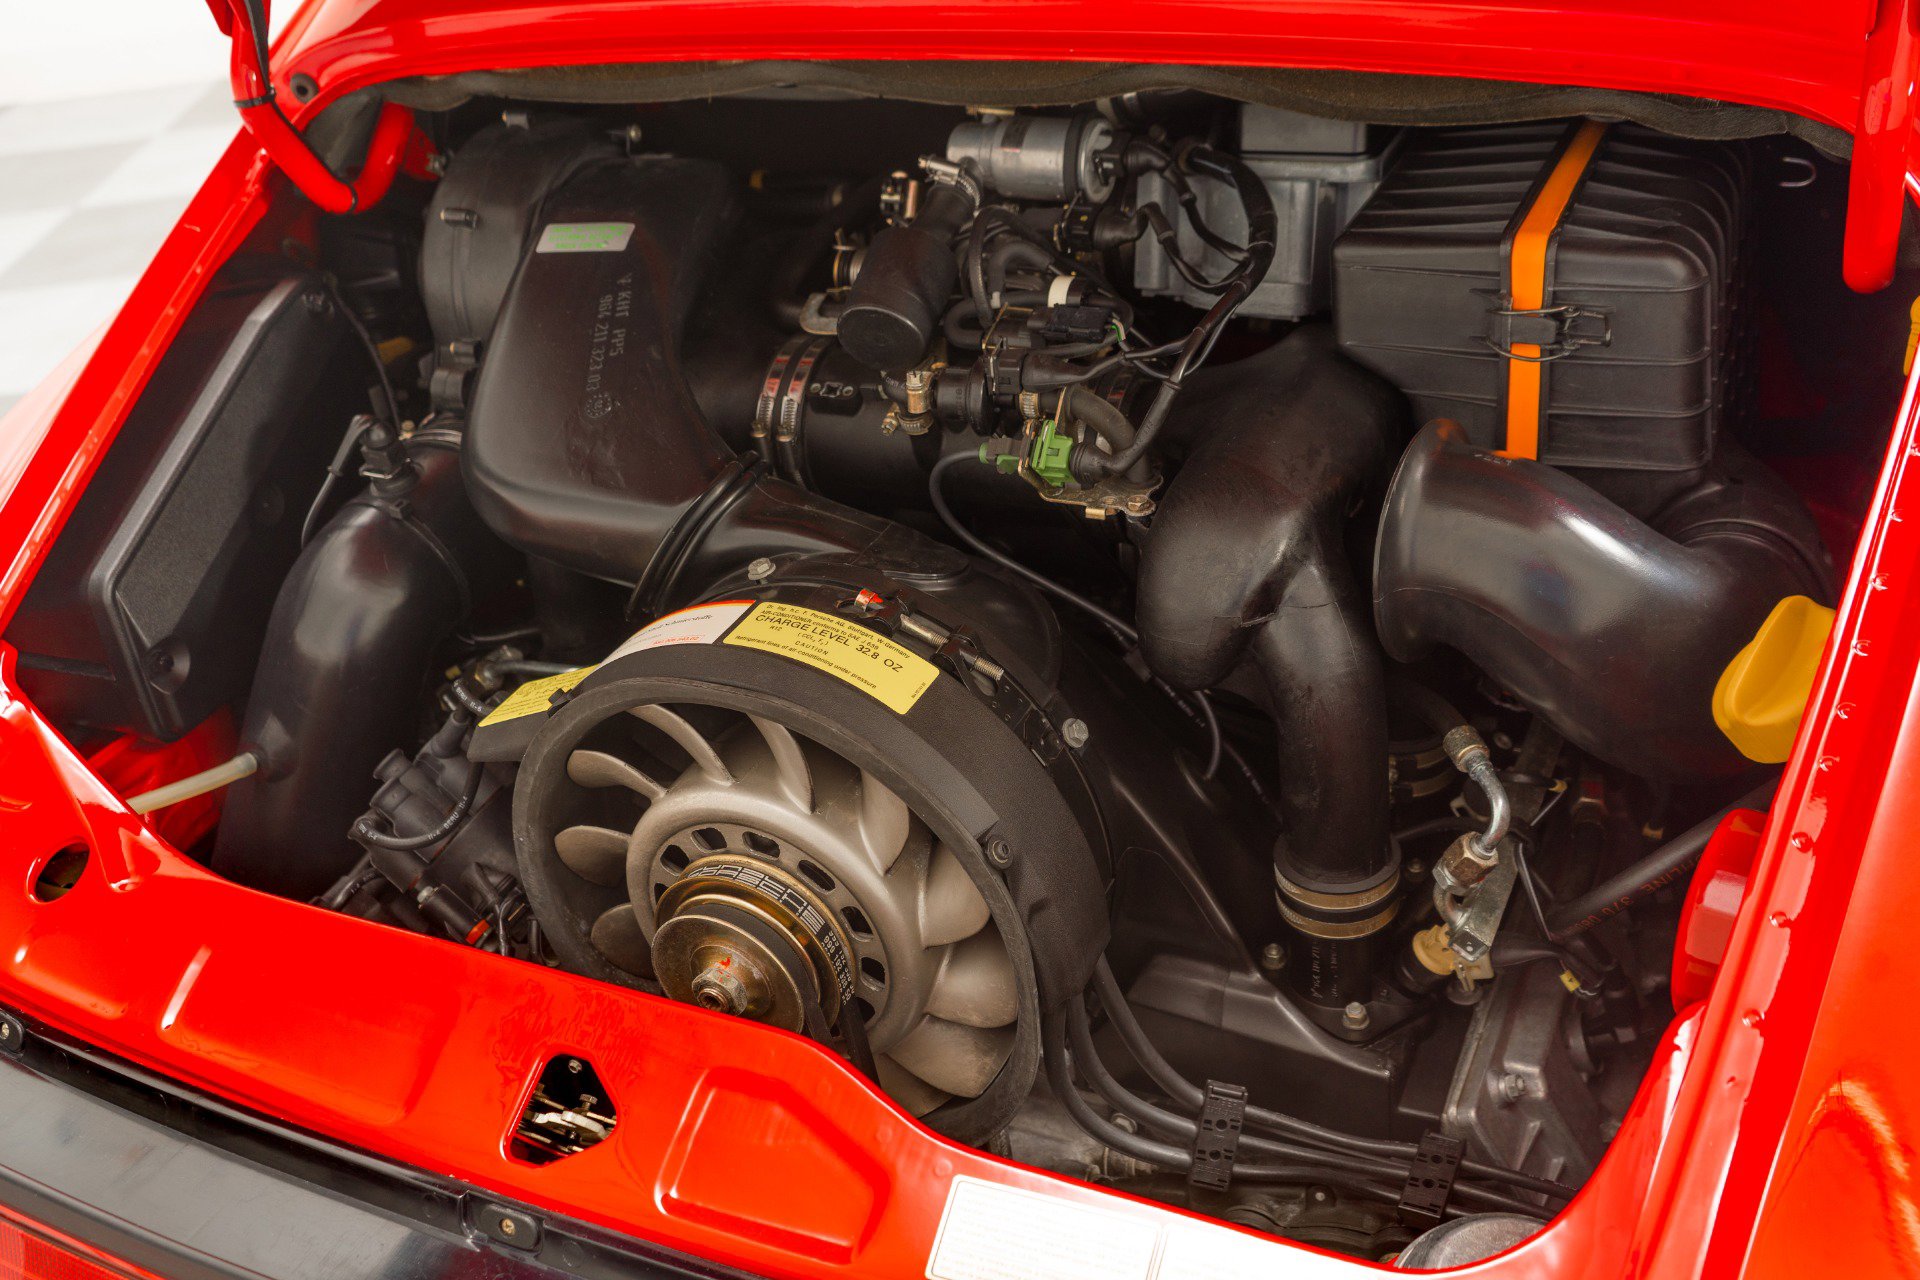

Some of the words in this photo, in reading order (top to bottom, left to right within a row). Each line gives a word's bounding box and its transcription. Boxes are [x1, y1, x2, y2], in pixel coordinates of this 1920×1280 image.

[755, 614, 809, 632] CHARGE
[813, 625, 851, 647] LEVEL
[855, 644, 881, 660] 32.8
[883, 658, 904, 673] OZ
[760, 609, 814, 625] AIR-CONDITIONER
[847, 631, 862, 643] SAE
[794, 640, 830, 656] CAUTION
[734, 635, 766, 646] Refrigerant
[766, 640, 780, 650] lines
[788, 645, 834, 668] air-conditioning
[833, 662, 852, 676] under
[851, 670, 878, 690] pressure
